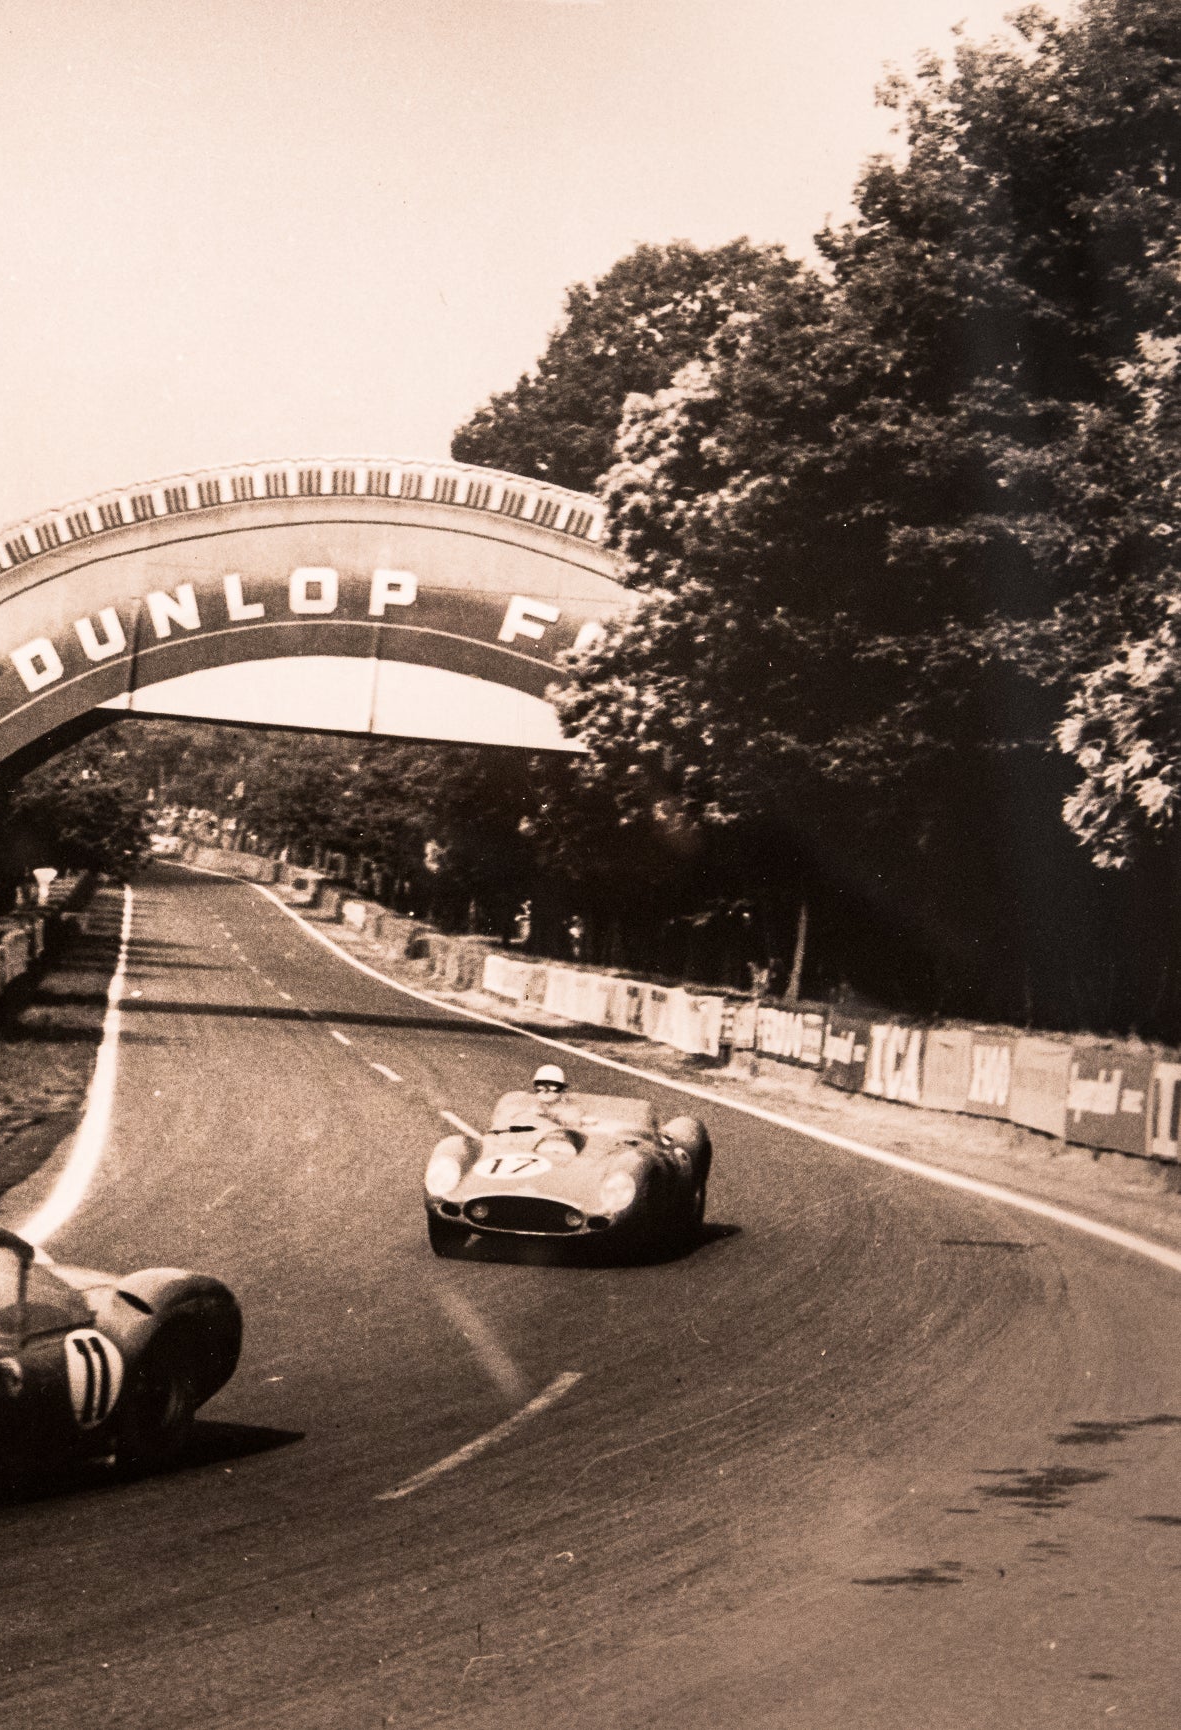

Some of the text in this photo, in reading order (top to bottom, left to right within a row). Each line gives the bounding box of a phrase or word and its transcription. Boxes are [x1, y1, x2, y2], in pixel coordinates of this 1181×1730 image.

[9, 567, 418, 693] DUNLOP
[490, 1158, 539, 1174] 17
[73, 1336, 111, 1422] 11
